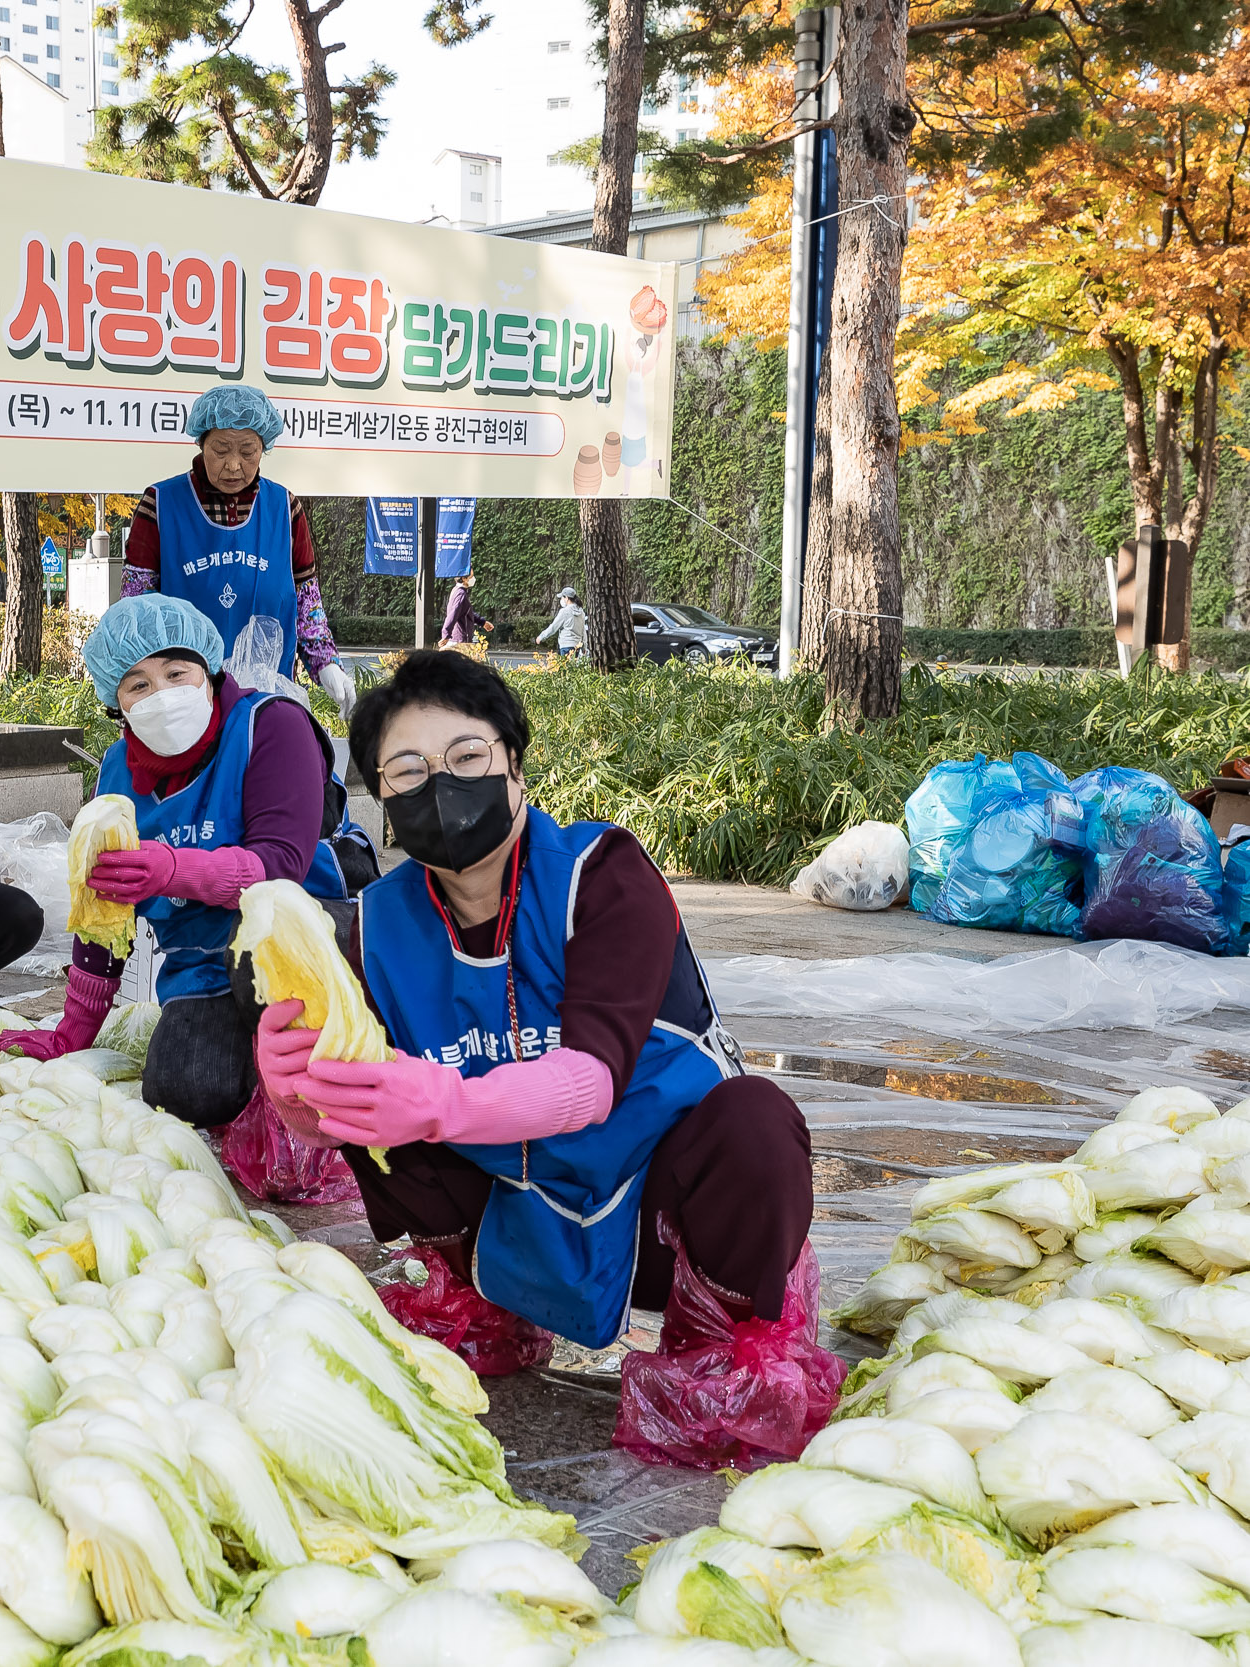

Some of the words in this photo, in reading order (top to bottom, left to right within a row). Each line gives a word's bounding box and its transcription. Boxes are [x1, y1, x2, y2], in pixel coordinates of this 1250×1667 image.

[9, 239, 237, 363] 사랑의
[263, 268, 389, 375] 김장
[403, 302, 609, 390] 담가드리기
[8, 393, 51, 428] (목)
[150, 401, 188, 433] (금)
[434, 416, 528, 445] 광진구협의회
[182, 550, 269, 576] 바르게살기운동
